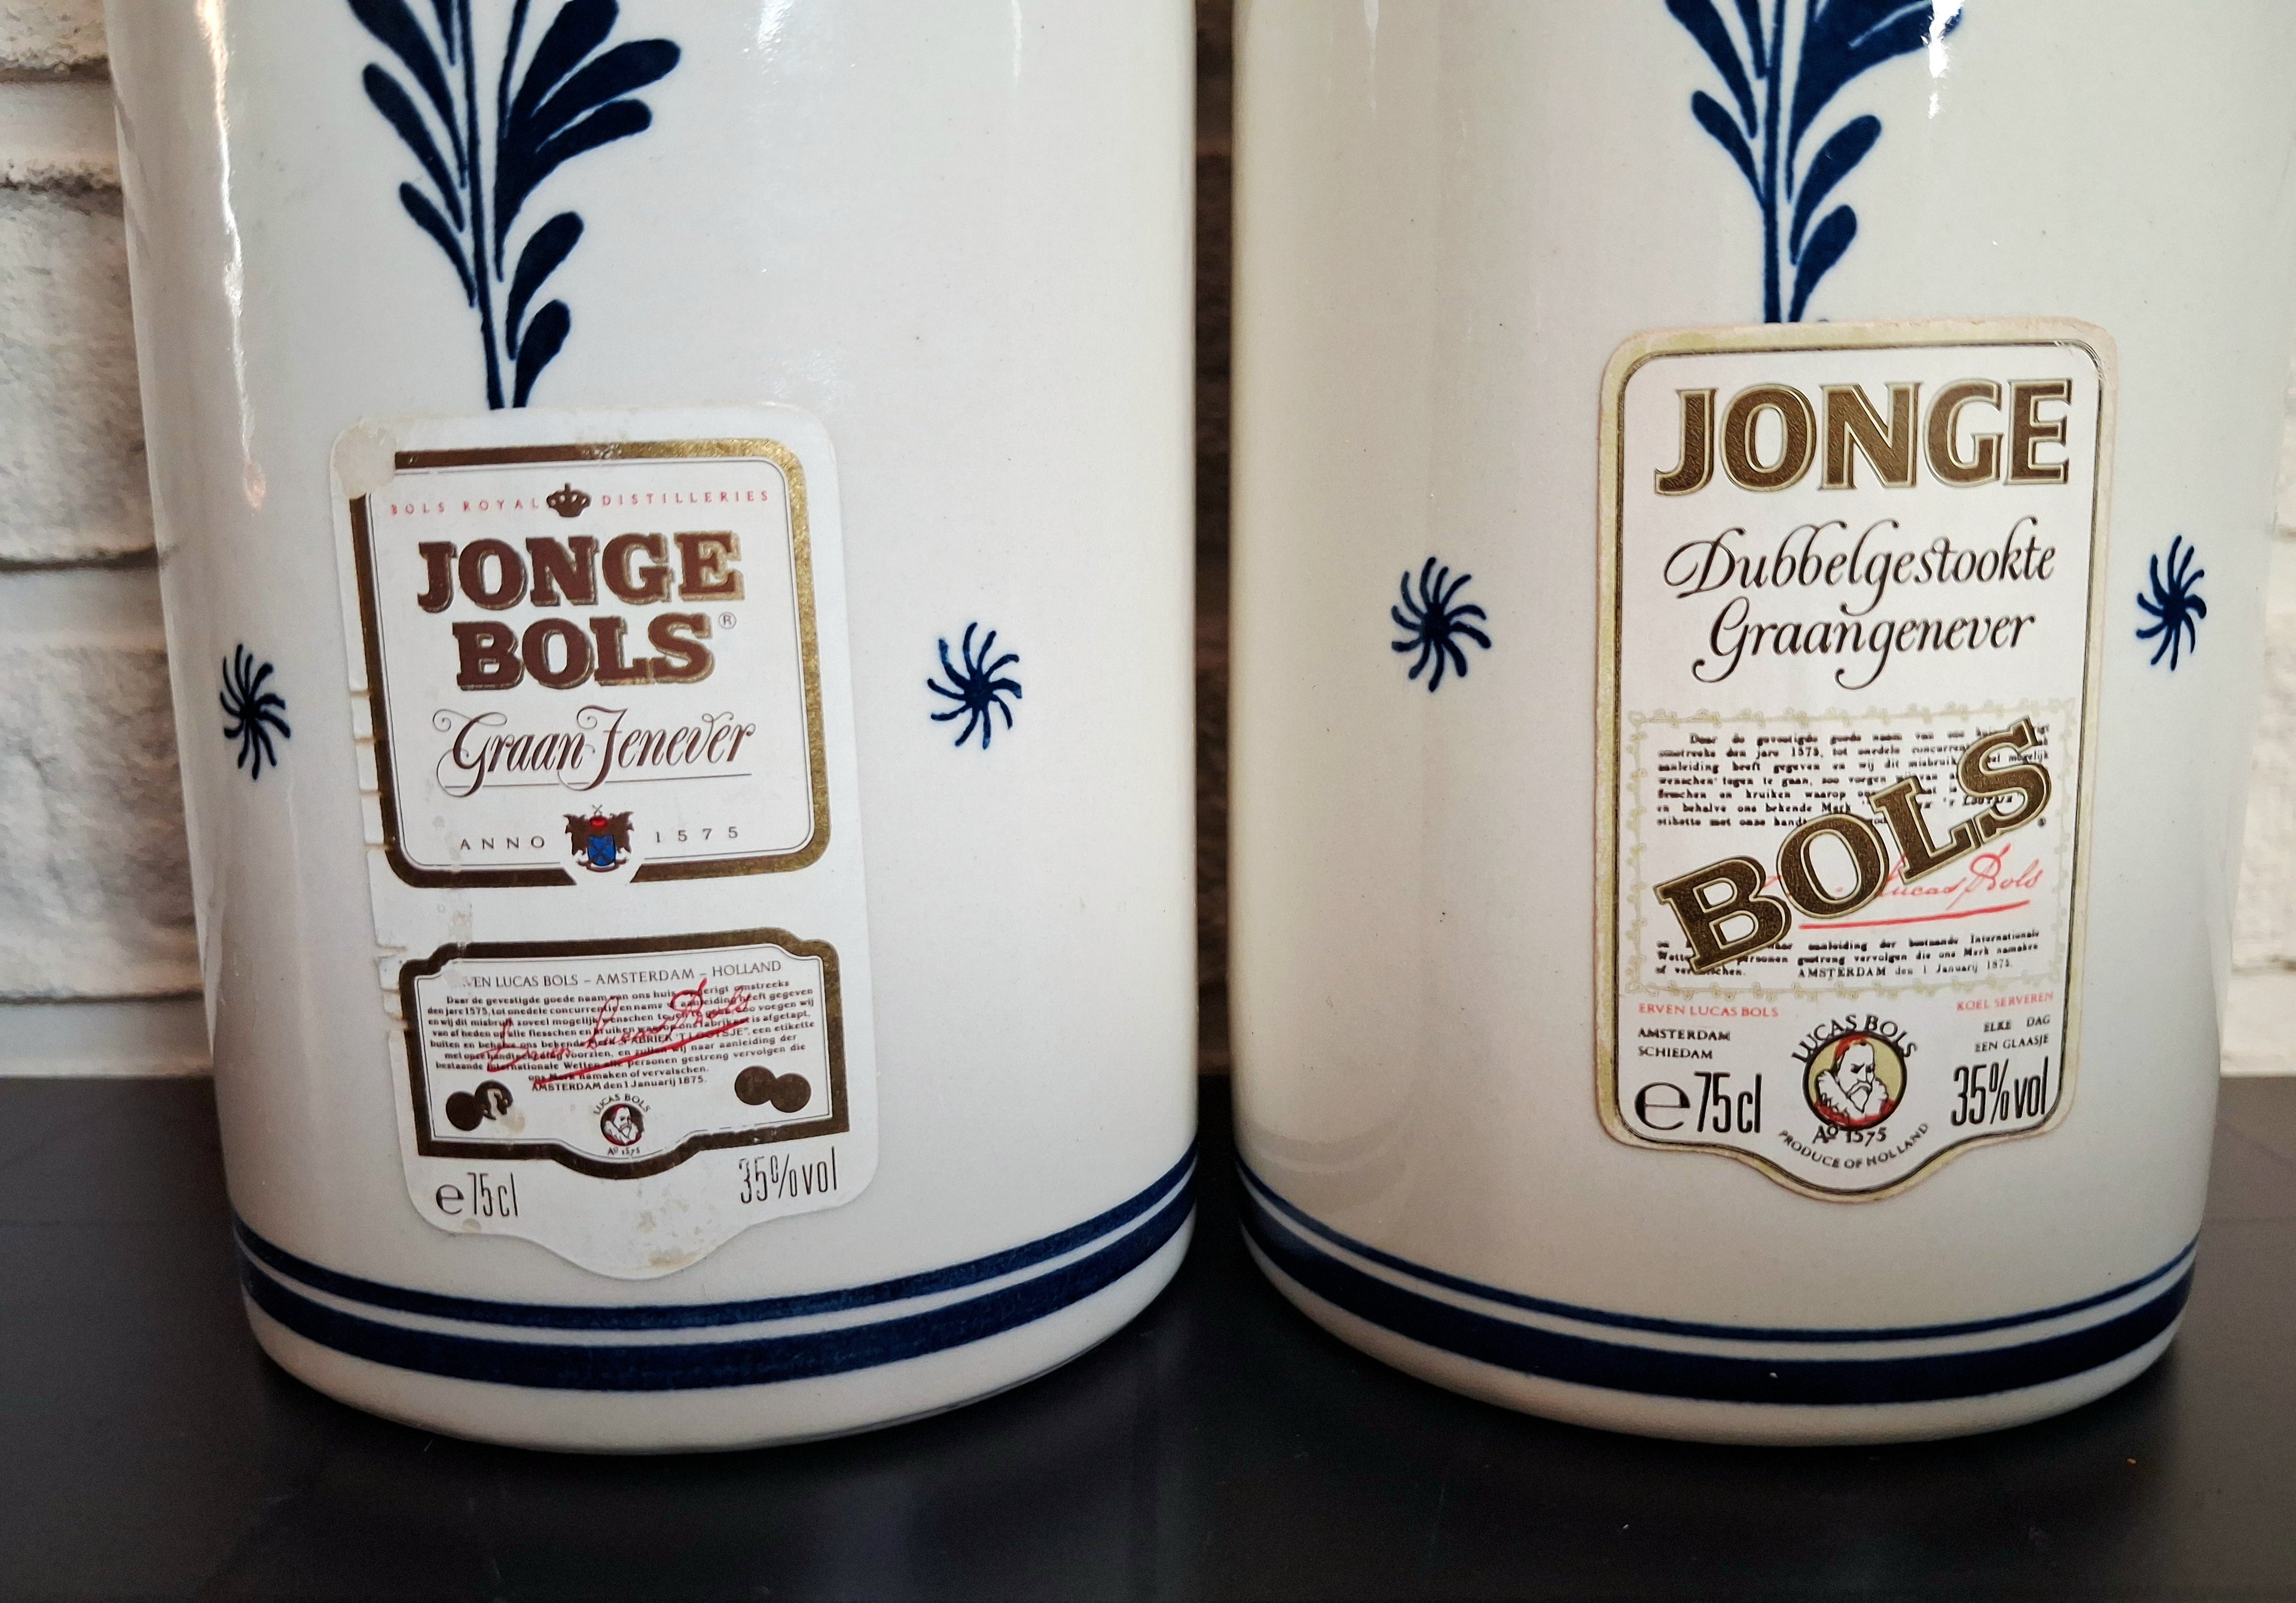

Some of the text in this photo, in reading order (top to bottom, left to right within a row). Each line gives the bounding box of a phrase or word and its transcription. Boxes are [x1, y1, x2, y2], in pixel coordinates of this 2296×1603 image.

[1654, 377, 2073, 496] JONGE
[391, 490, 768, 515] BOLS ROYAL DISTILLERIES
[417, 531, 745, 613] JONGE
[1663, 515, 2056, 616] Dubbelgestookte
[452, 612, 715, 691] BOLS
[1690, 596, 2036, 691] Graangenever
[432, 705, 756, 798] Graan Jenever
[460, 826, 739, 851] ANNO 1575
[1653, 717, 2051, 973] BOLS
[496, 960, 781, 987] LUCAS BOLS AMSTERDAM HOLLAND
[1798, 967, 1885, 978] AMSTERDAM
[446, 1007, 464, 1016] jare
[770, 988, 813, 1000] gegeven
[447, 996, 469, 1004] Daar
[486, 996, 541, 1005] gevestigde
[544, 994, 575, 1004] goede
[654, 990, 676, 998] huis
[1956, 991, 2053, 1010] KOEL SERVEREN
[441, 1019, 453, 1027] wij
[759, 1002, 796, 1010] voegen
[1639, 1003, 1779, 1017] ERVEN LUCAS BOLS
[774, 1021, 815, 1032] etikette
[1638, 1027, 1730, 1041] AMSTERDAM
[1983, 1014, 2051, 1033] ELKE DAG
[720, 1037, 775, 1048] aanleiding
[1790, 1013, 1918, 1063] LUCAS BOLS
[1974, 1033, 2049, 1052] EEN GLAASJE
[436, 1061, 483, 1069] bestaande
[628, 1057, 677, 1068] personen
[734, 1046, 785, 1058] vervolgen
[1638, 1046, 1713, 1059] SCHIEDAM
[631, 1077, 676, 1087] Januarij
[643, 1066, 709, 1076] vervalschen.
[593, 1093, 651, 1115] LUCAS BOLS
[1779, 1122, 1929, 1169] PRODUCE OF HOLLAND
[1846, 1126, 1887, 1147] 1575
